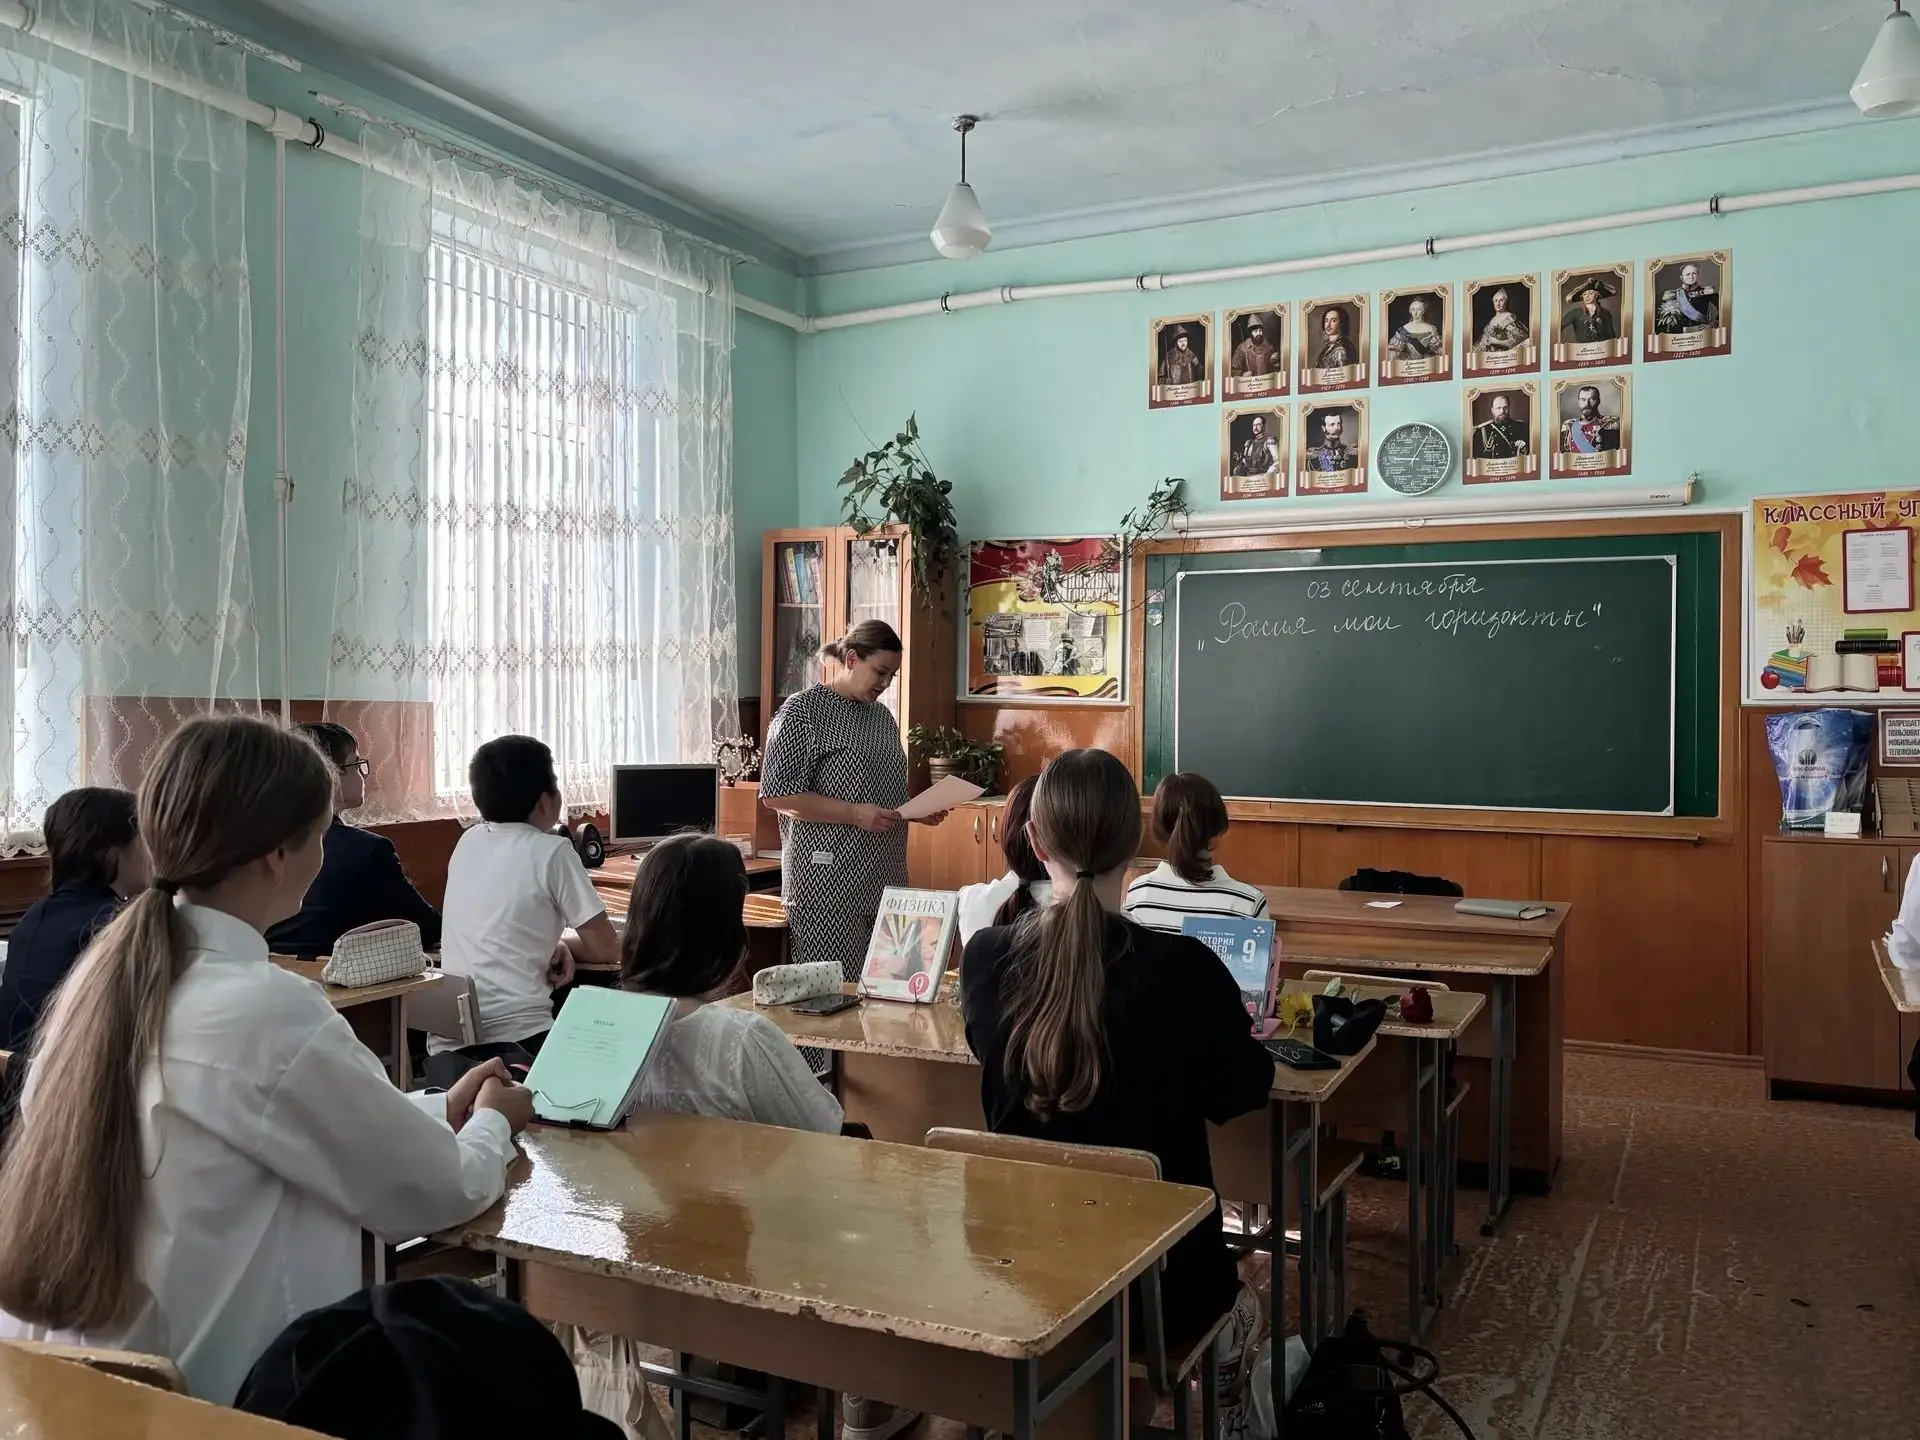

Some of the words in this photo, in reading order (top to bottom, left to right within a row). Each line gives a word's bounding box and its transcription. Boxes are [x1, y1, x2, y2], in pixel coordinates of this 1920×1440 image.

[1763, 497, 1886, 524] КЛАССНЫЙ
[1307, 581, 1331, 598] 03
[1341, 574, 1484, 601] сентября
[1333, 615, 1402, 633] мои
[886, 898, 945, 914] ФИЗИКА
[1241, 938, 1257, 964] 9
[915, 975, 925, 993] 9
